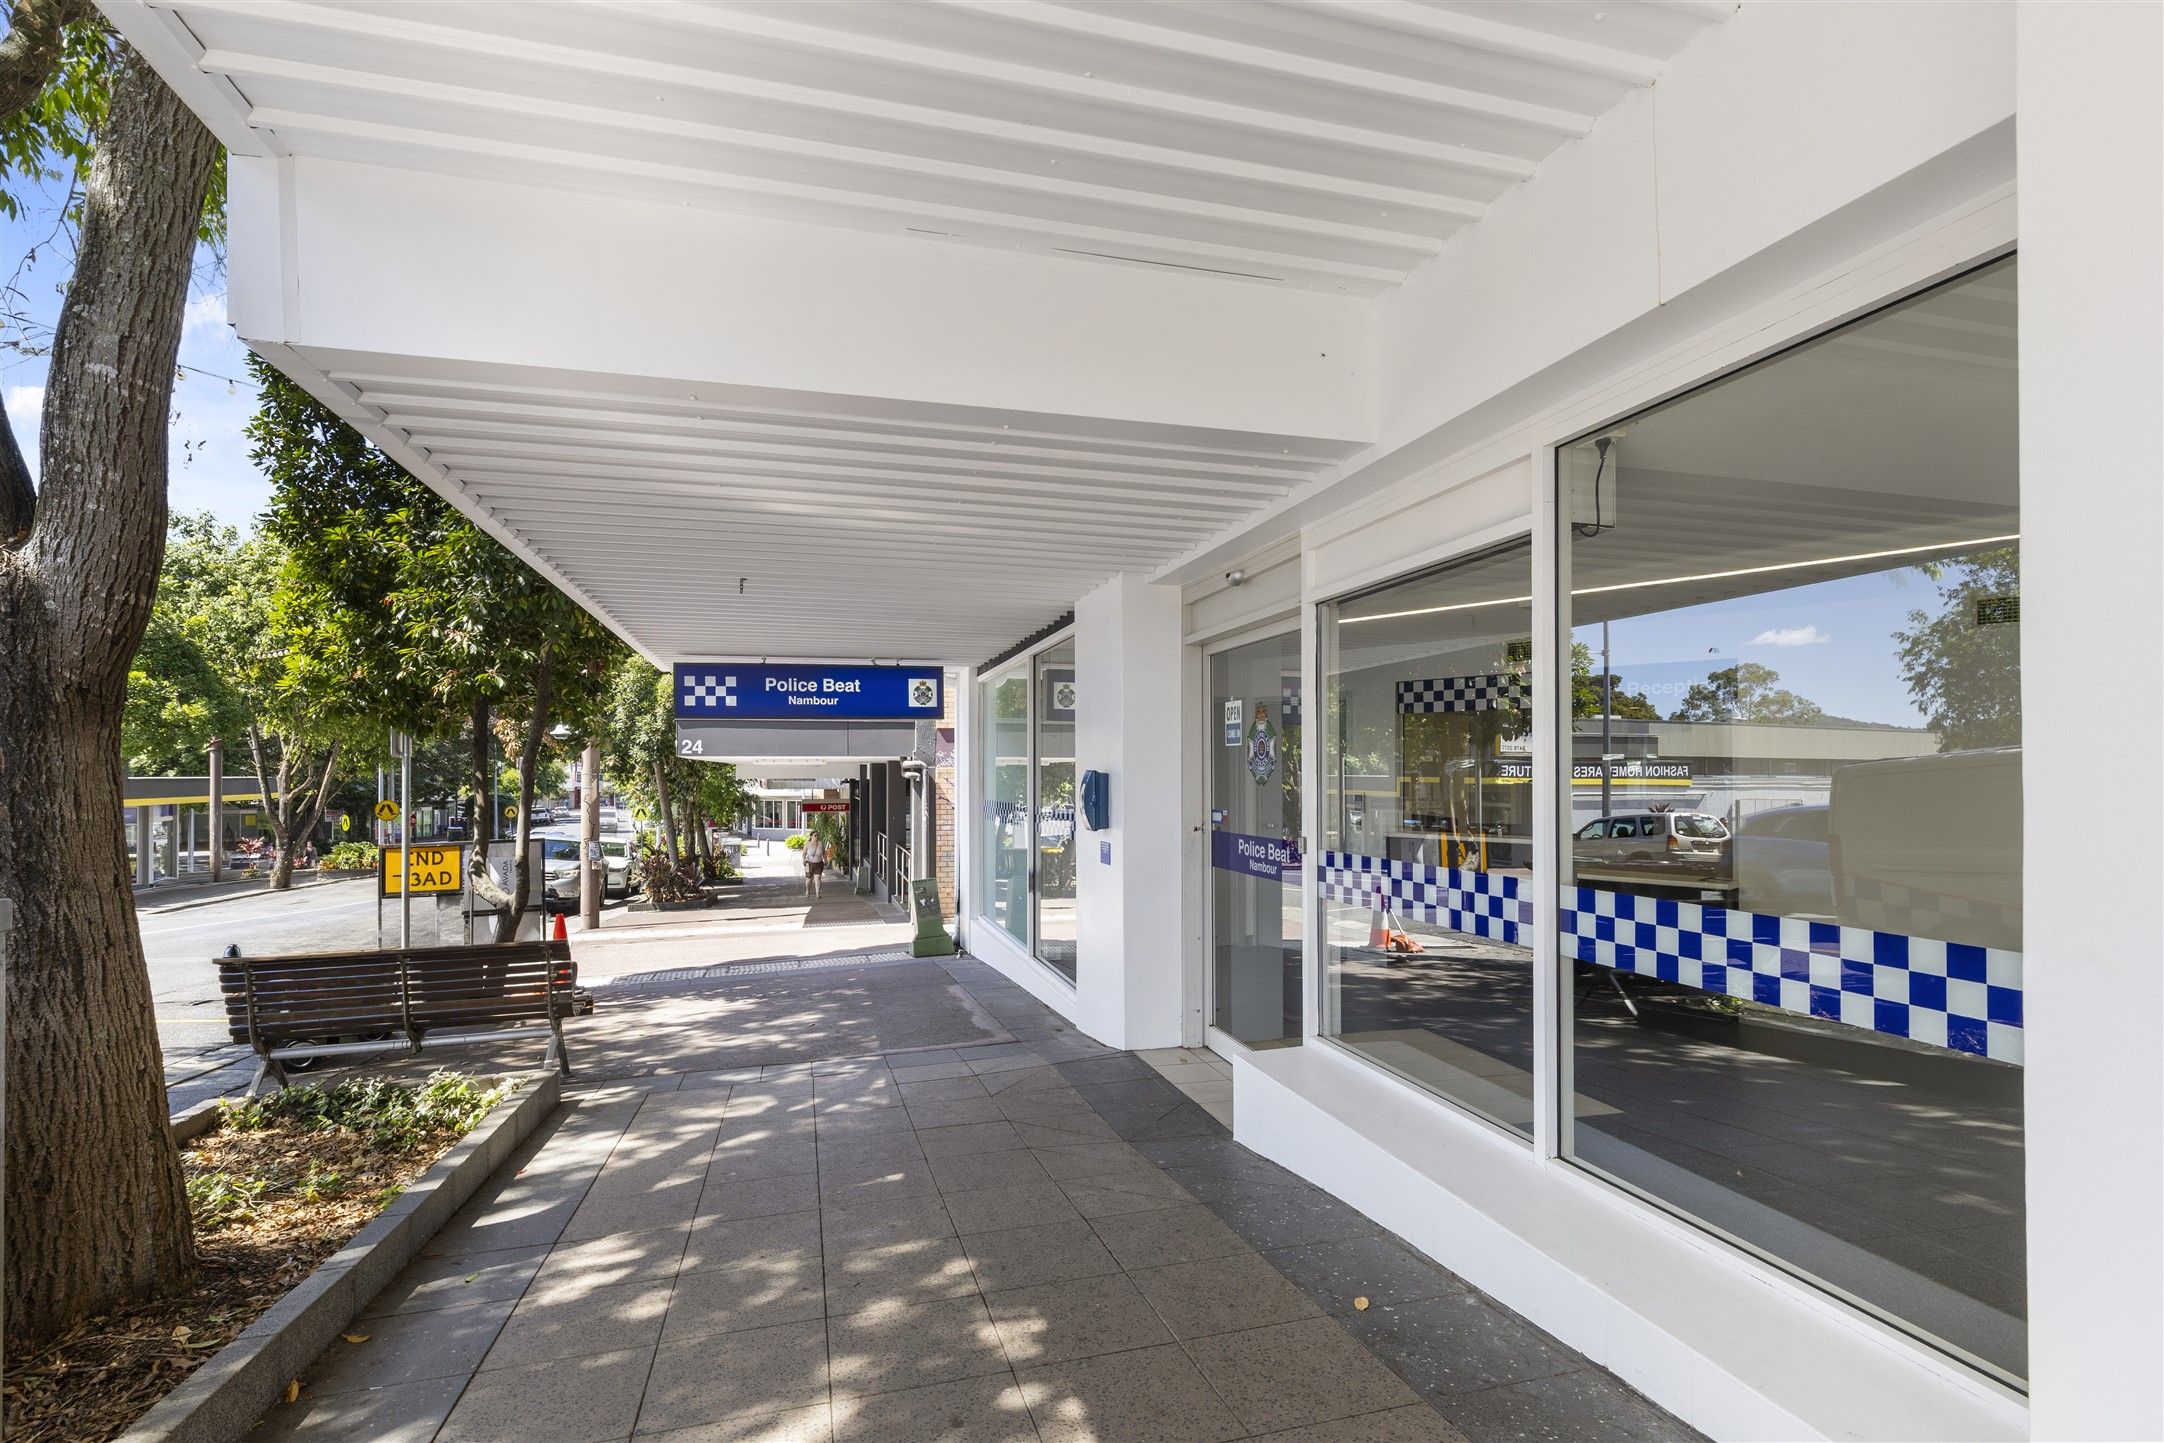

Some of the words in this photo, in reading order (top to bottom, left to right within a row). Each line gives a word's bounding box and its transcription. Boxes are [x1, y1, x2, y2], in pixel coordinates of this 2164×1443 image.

[765, 677, 818, 692] Police
[822, 677, 861, 693] Beat
[788, 695, 839, 706] Nambour
[1226, 706, 1241, 721] OPEN
[681, 739, 704, 754] 24
[1238, 838, 1266, 859] Police
[1267, 843, 1291, 863] Beat
[1249, 859, 1278, 875] Nambour
